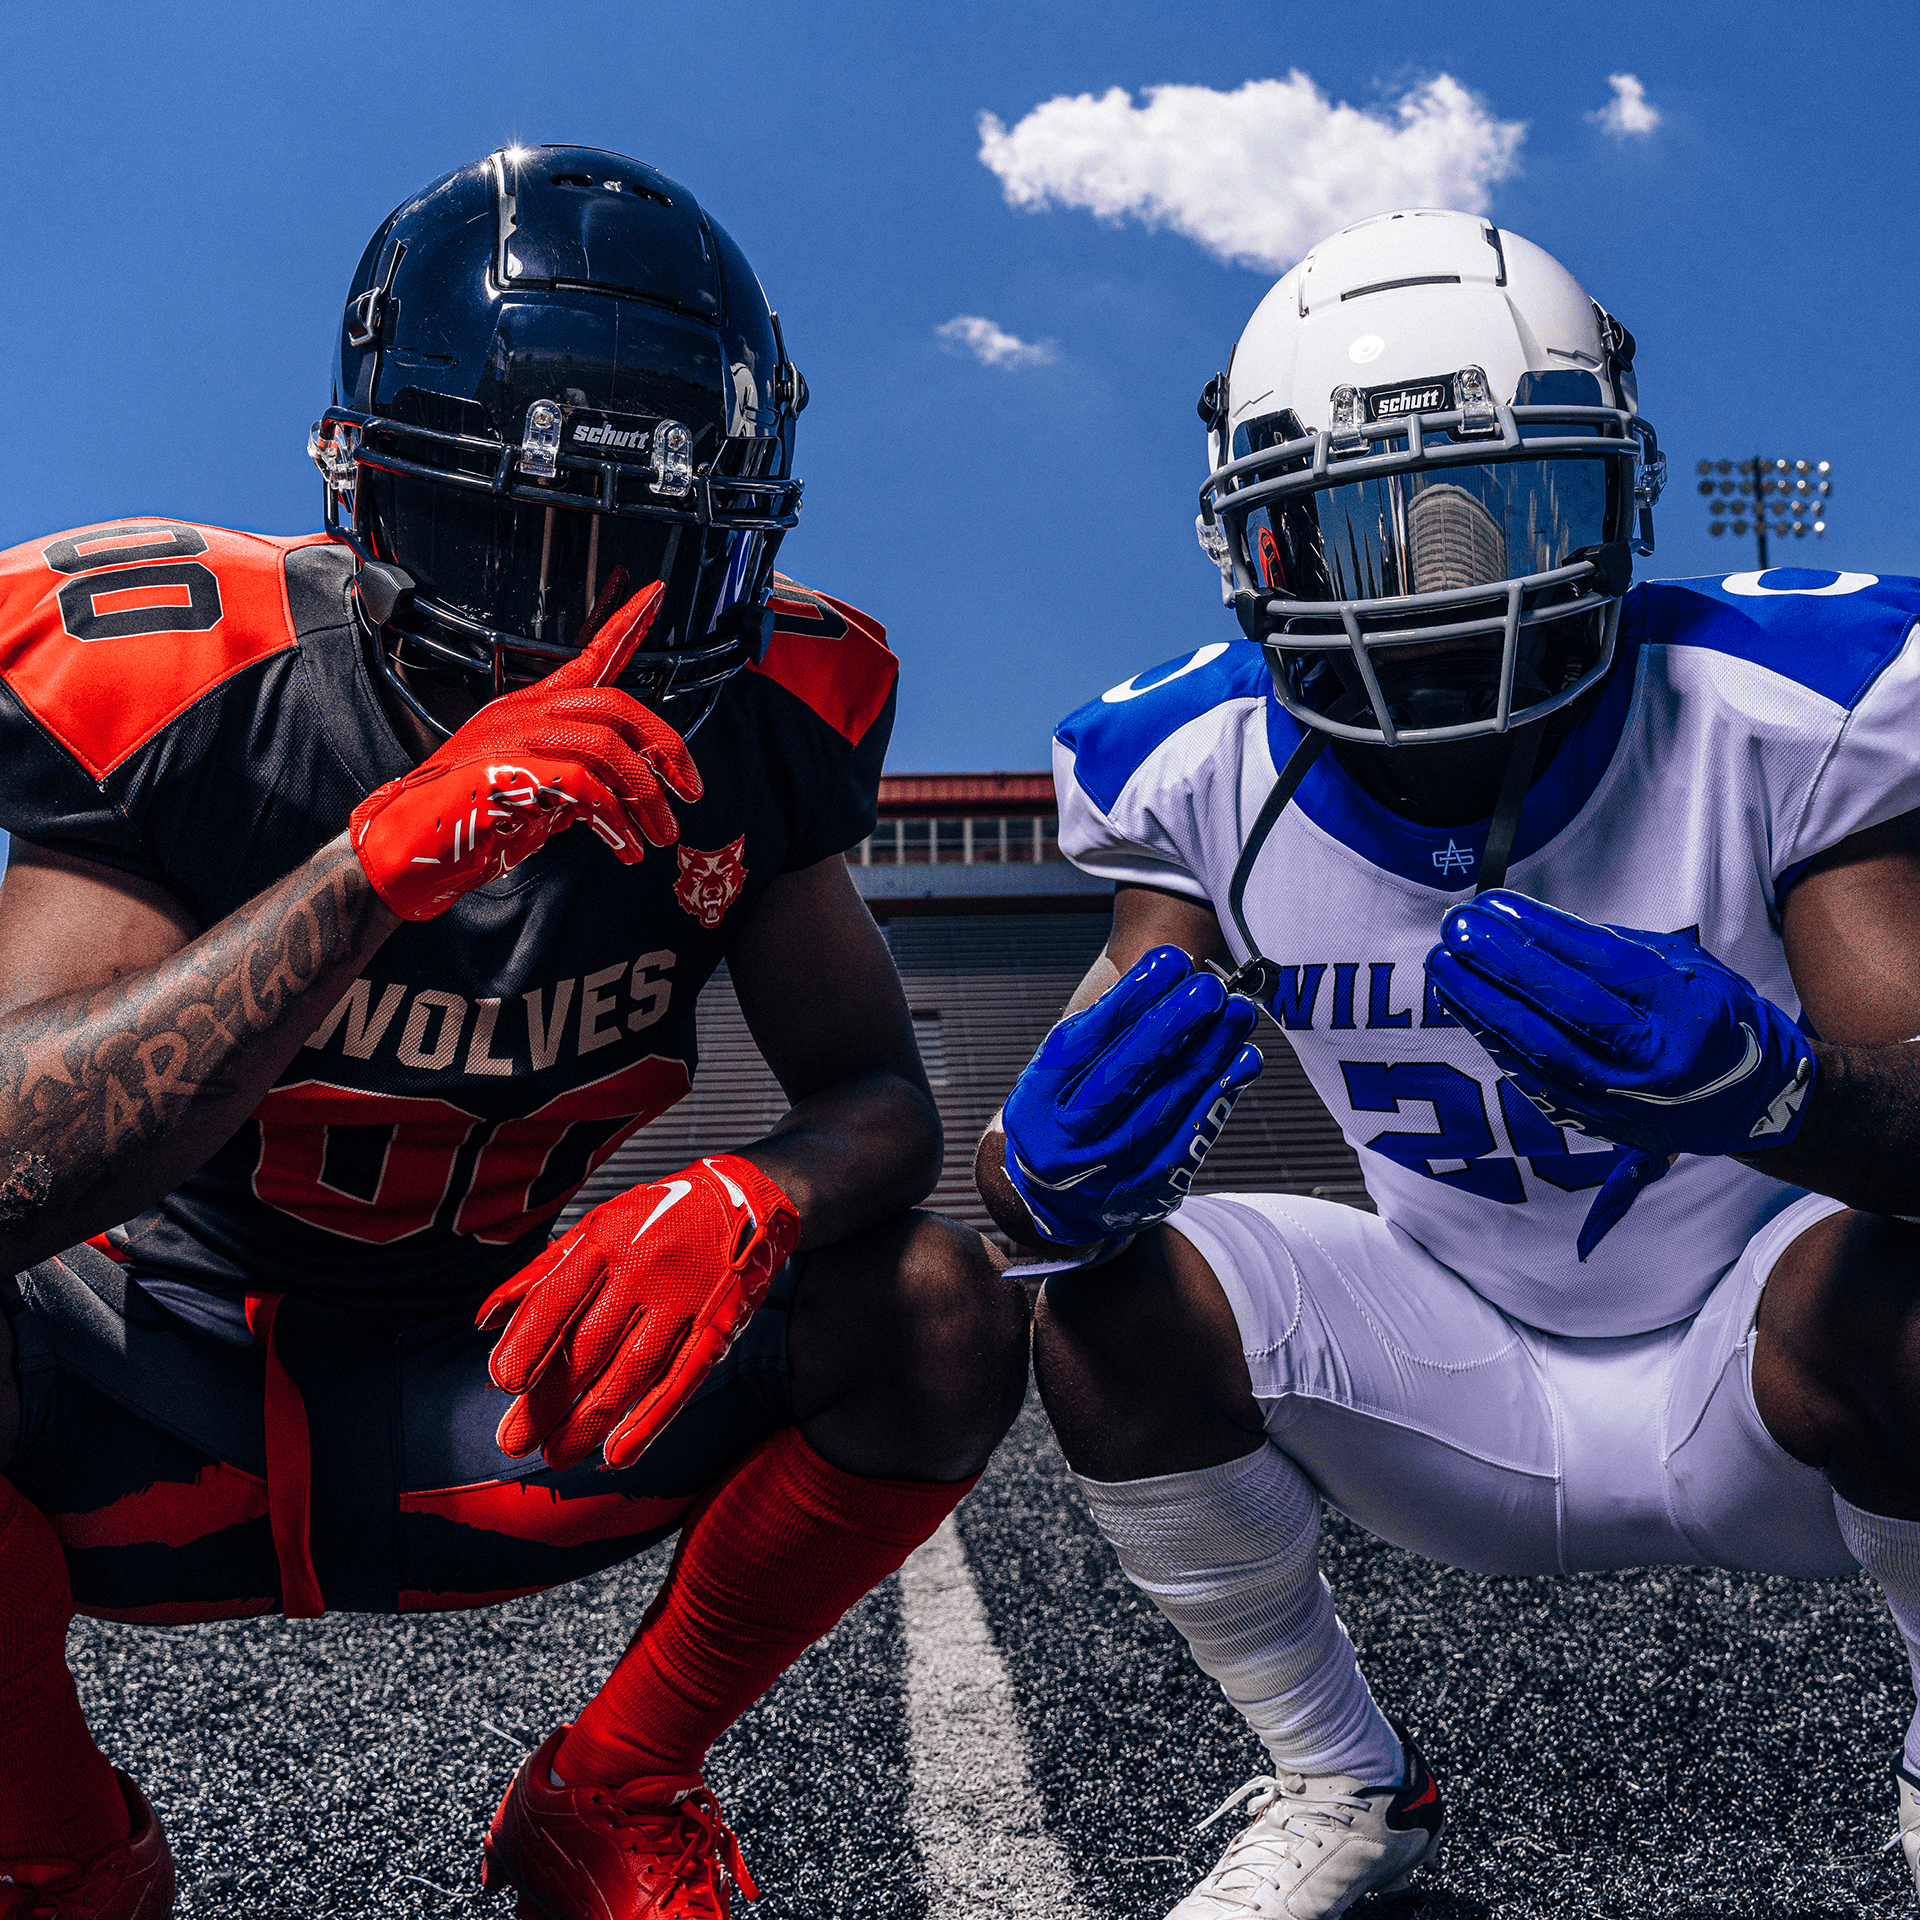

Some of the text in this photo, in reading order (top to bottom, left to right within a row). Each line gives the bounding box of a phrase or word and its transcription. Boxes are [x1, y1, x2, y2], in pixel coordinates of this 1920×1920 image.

[1378, 390, 1439, 414] schutt
[573, 424, 649, 449] schutt
[304, 949, 677, 1077] WOLVES
